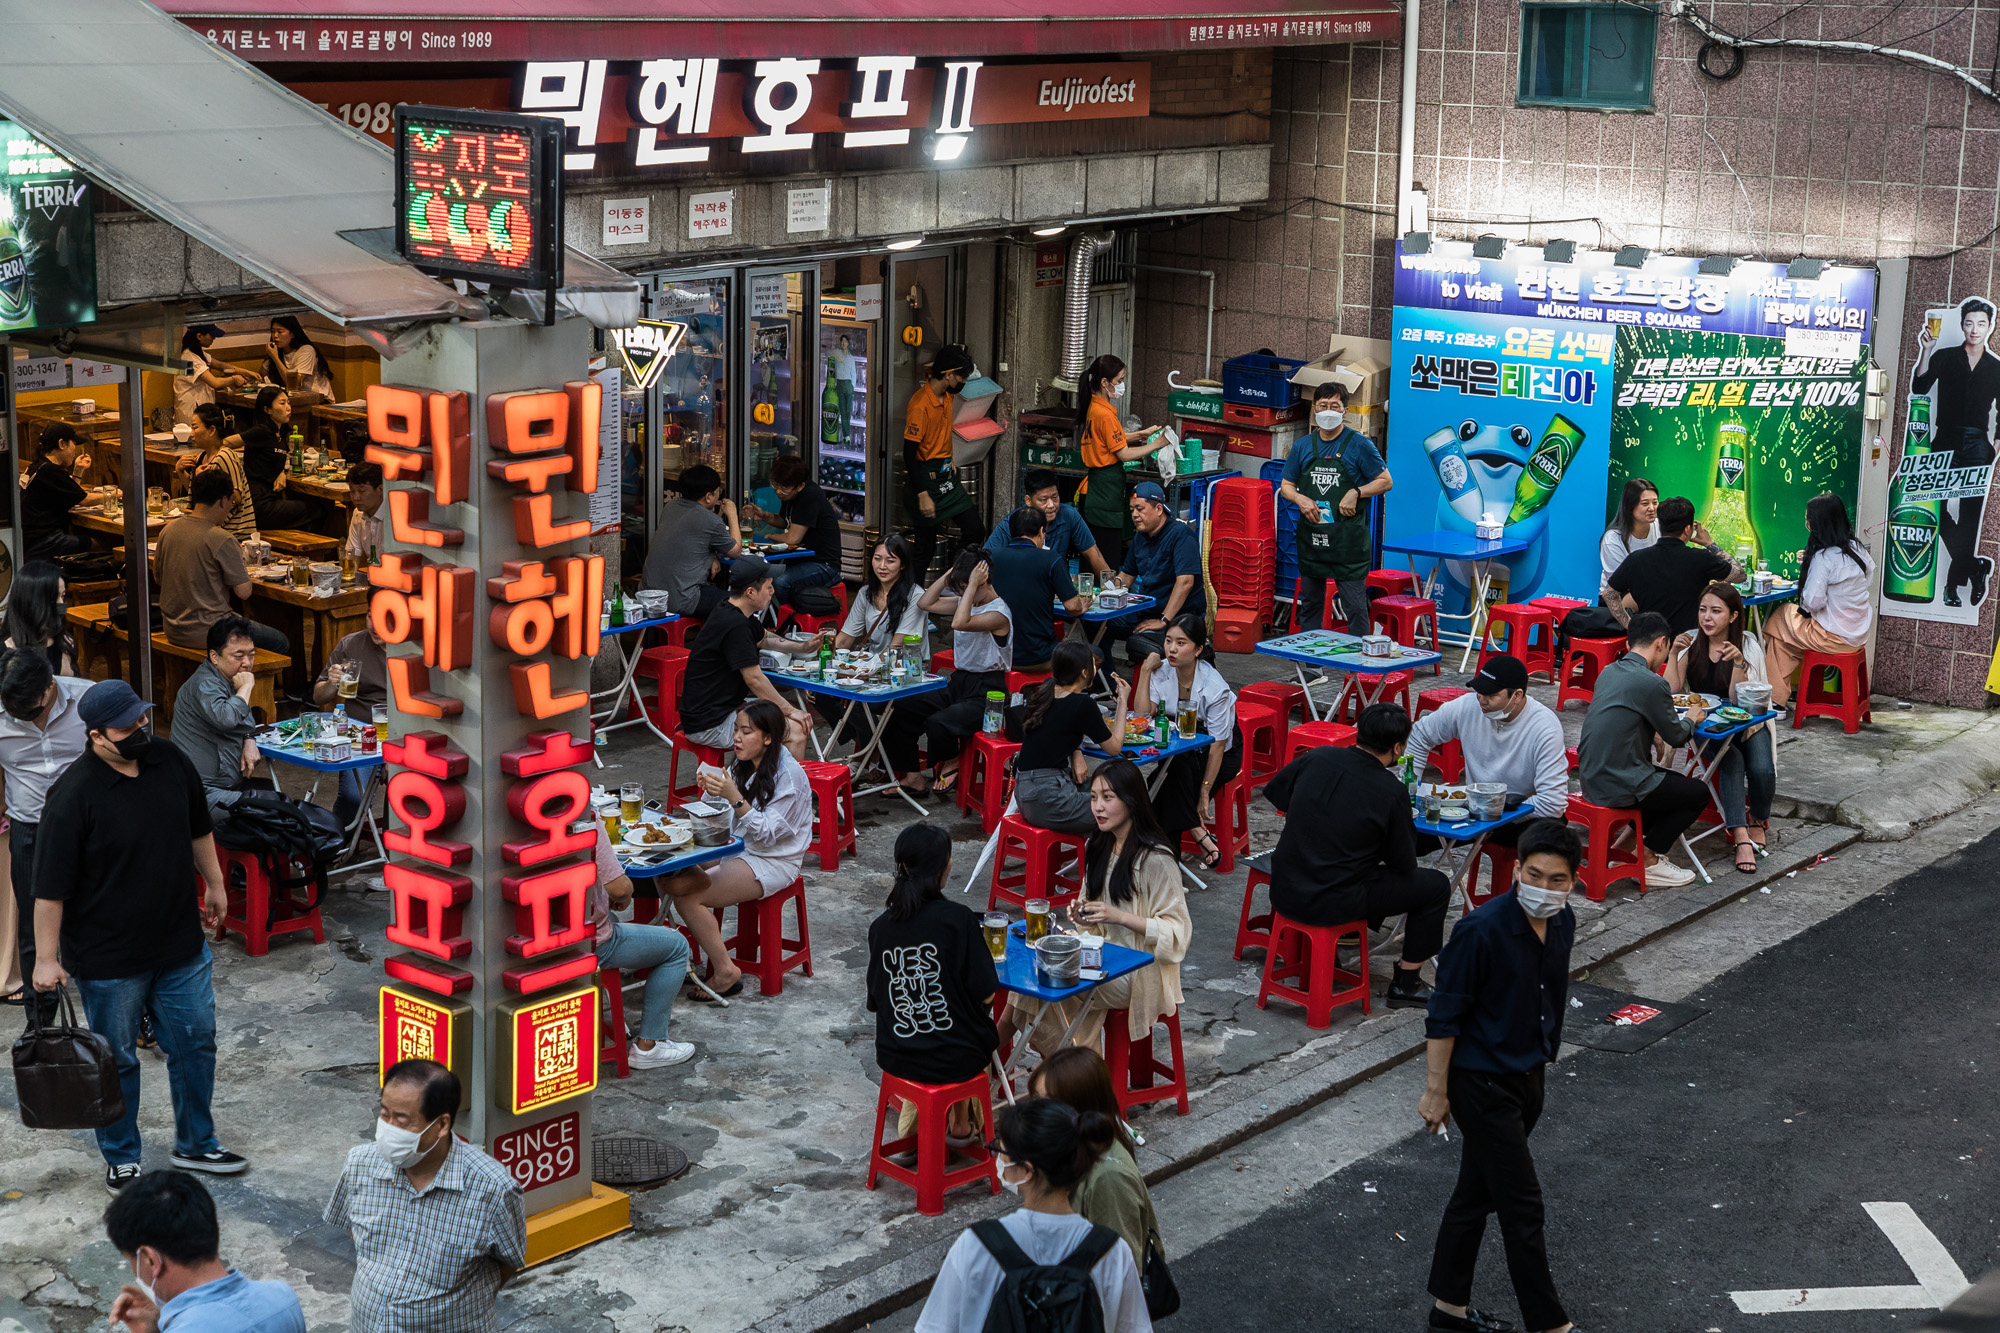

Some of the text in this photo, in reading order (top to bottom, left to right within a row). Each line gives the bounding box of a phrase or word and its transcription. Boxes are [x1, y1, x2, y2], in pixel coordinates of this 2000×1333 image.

[317, 29, 413, 51] 을지로골뱅이
[421, 31, 456, 49] Since
[461, 31, 493, 49] 1989
[1189, 20, 1372, 42] 뮌헨호프 을지로노가리 을지로골뱅이 Since 1989
[1038, 76, 1137, 113] Euljirofest
[338, 101, 409, 134] 198
[520, 56, 917, 170] 뮌헨호프
[20, 185, 79, 210] TERRA
[694, 201, 728, 214] 꼭착용
[608, 207, 645, 219] 이동중
[692, 217, 729, 231] 해주세요
[608, 224, 645, 236] 마스크
[1036, 267, 1063, 280] SECOM
[1441, 279, 1503, 302] to visit
[1515, 264, 1729, 314] 뮌헨 호프광장
[822, 305, 856, 316] Aqua FIN
[1537, 301, 1702, 329] MÜNCHEN BEER SQUARE
[1763, 301, 1867, 330] 골뱅이 있어요!
[1401, 327, 1422, 342] 요즘
[1424, 330, 1445, 344] 맥주
[1501, 326, 1614, 366] 요즘 쏘맥
[1632, 357, 1669, 376] 다른
[1668, 357, 1721, 375] 탄산은
[1410, 354, 1597, 406] 쏘맥은 테진아
[1616, 382, 1688, 407] 강력한
[1748, 382, 1802, 407] 탄산
[1801, 381, 1862, 406] 100%
[823, 411, 837, 419] TERRA
[1908, 422, 1930, 433] TERRA
[1534, 452, 1562, 480] TERRA
[1719, 458, 1744, 472] TERRA
[1900, 452, 1951, 474] 이 맛이
[1311, 473, 1340, 488] TERRA
[1904, 466, 1990, 493] 청정라거다!
[1892, 525, 1933, 545] TERRA
[364, 384, 456, 996] 뮌헨호프
[502, 383, 606, 995] 뮌헨호프
[531, 997, 582, 1021] 을지로 노가리 골목
[402, 1024, 430, 1047] 서울
[540, 1023, 573, 1046] 서울
[402, 1038, 430, 1061] 미래
[540, 1038, 573, 1061] 미래
[540, 1052, 573, 1076] 유산
[501, 1118, 574, 1163] SINCE
